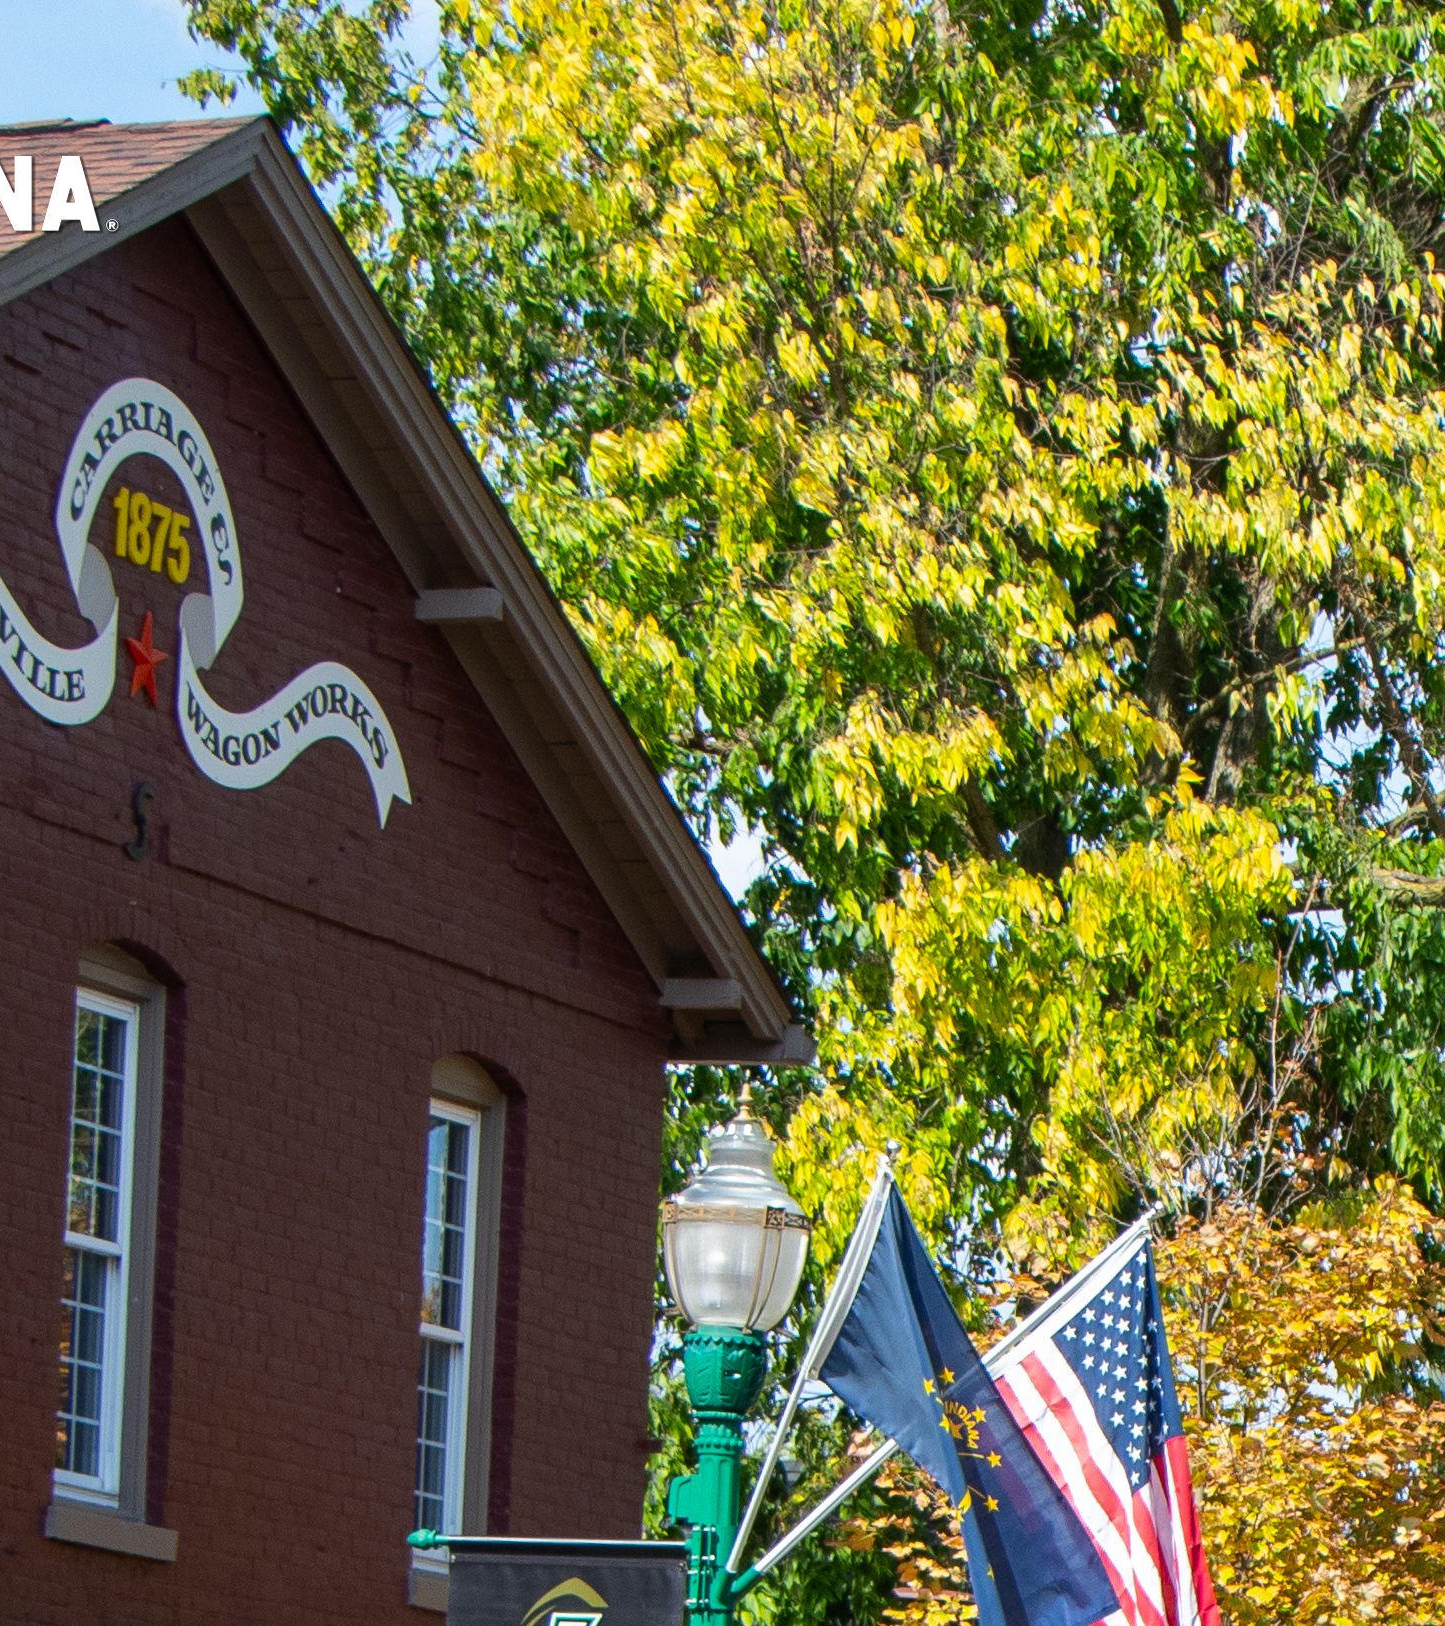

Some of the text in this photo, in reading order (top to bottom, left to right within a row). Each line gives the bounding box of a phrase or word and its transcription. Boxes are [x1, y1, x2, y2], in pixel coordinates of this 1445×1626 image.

[70, 401, 215, 521] CARRIAGE
[113, 487, 191, 584] 1875
[185, 679, 389, 769] WAGON WORKS
